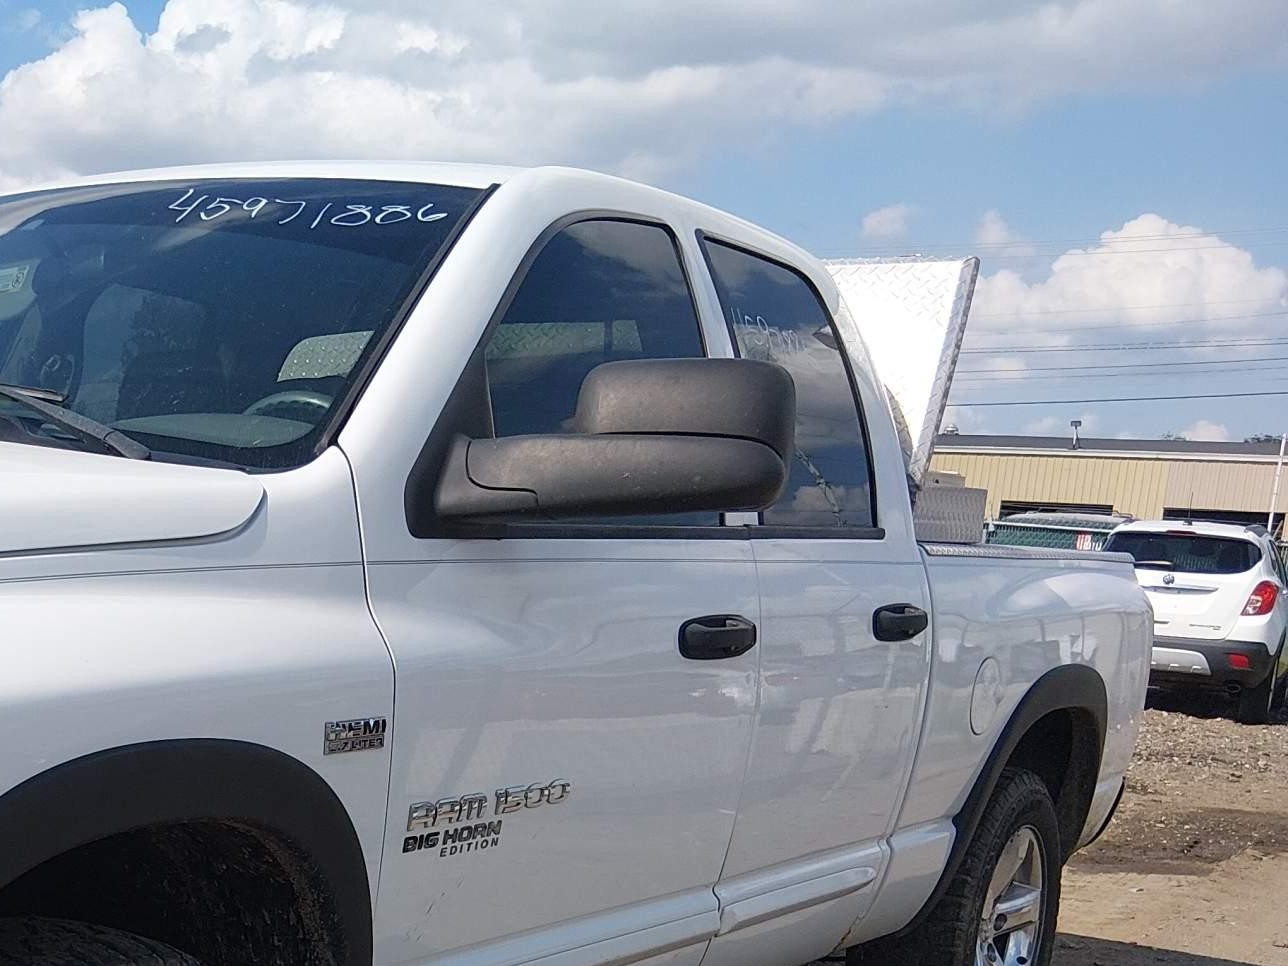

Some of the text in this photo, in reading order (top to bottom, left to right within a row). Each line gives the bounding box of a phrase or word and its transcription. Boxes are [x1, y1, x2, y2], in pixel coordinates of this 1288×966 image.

[168, 188, 448, 229] 45971886
[407, 778, 570, 832] RAM 1500
[402, 820, 502, 853] BIG HORN
[439, 838, 499, 857] EDITION
